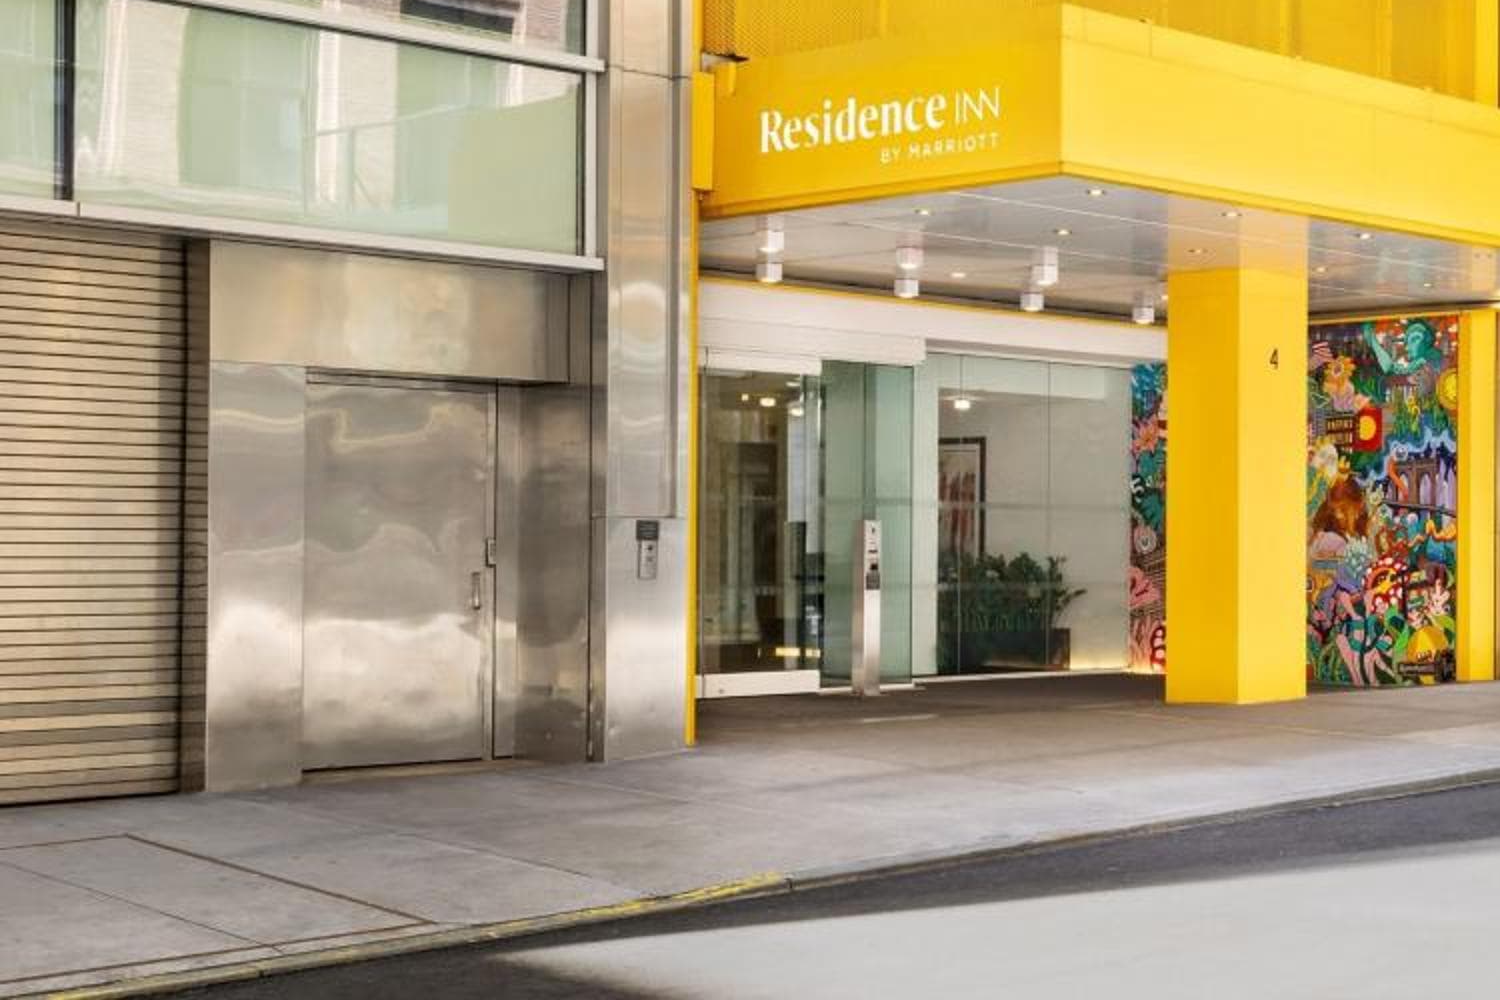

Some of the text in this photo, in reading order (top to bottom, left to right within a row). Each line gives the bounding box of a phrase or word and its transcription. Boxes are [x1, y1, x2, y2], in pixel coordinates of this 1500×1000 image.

[760, 88, 1000, 153] Residence INN
[880, 132, 999, 164] BY MARRIOTT
[1269, 348, 1279, 370] 4
